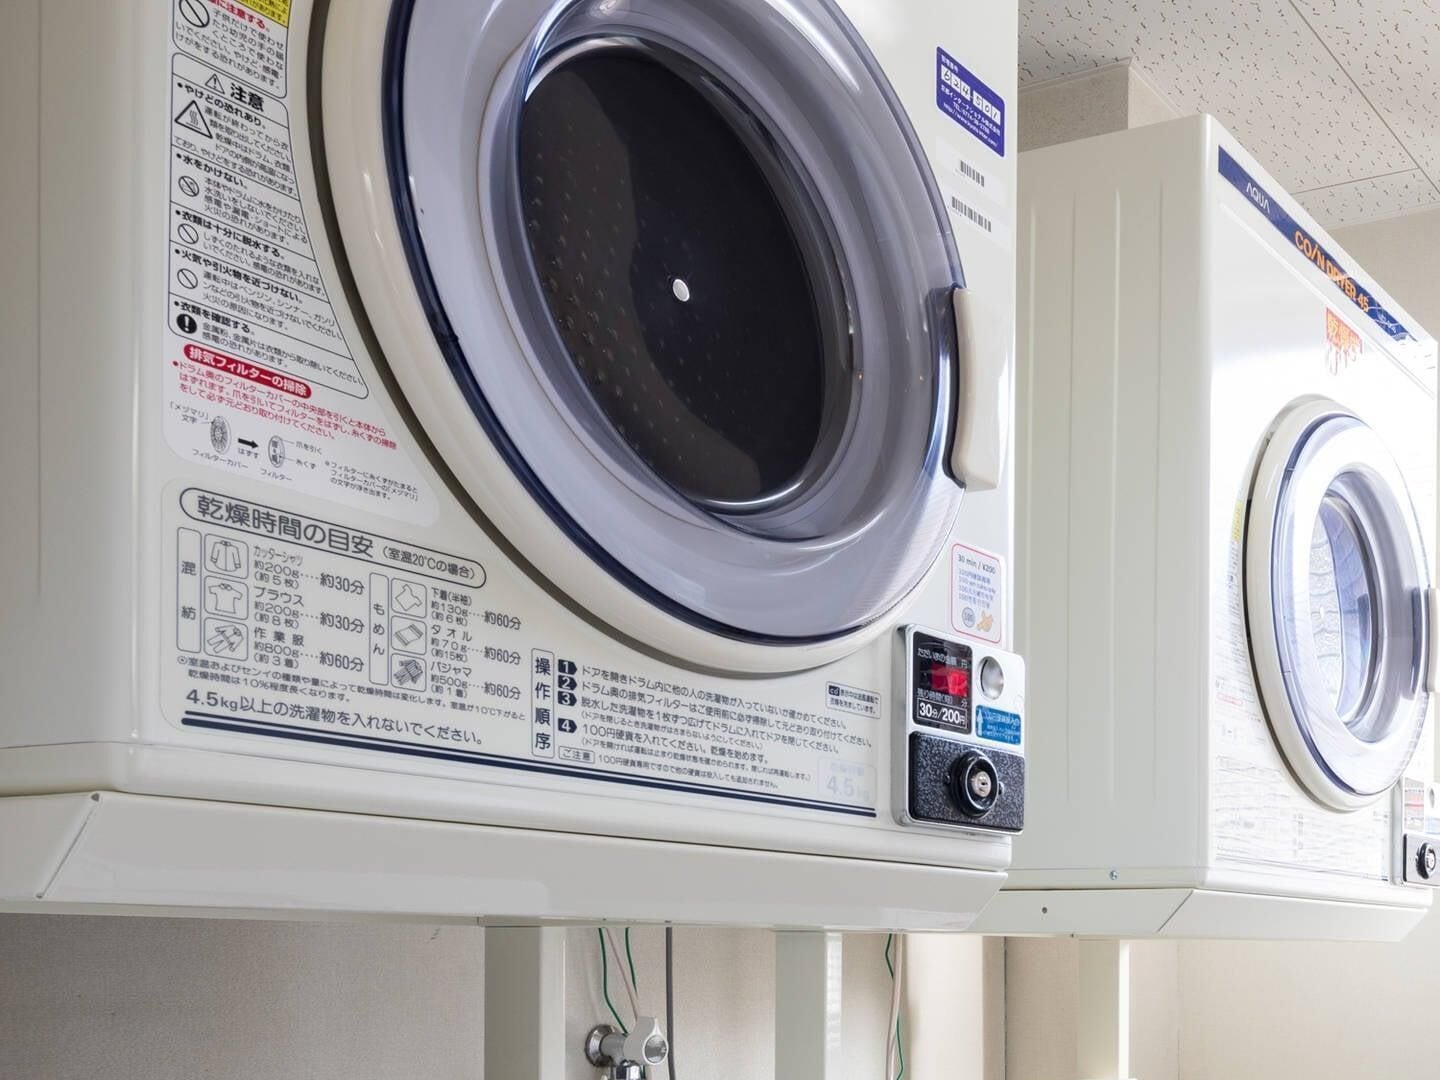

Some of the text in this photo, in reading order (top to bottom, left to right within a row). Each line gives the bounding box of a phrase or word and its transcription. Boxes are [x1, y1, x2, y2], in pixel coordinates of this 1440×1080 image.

[230, 81, 263, 113] 注意
[1246, 181, 1270, 213] AQUA
[1295, 230, 1324, 270] COIN
[188, 345, 306, 397] 排気フィルターの掃除
[196, 492, 374, 559] 乾燥時間の目安
[253, 585, 304, 608] ブラウス
[430, 660, 472, 678] パジャマ
[561, 676, 569, 689] 2
[534, 656, 551, 751] 操作順序
[561, 692, 569, 705] 3
[185, 685, 483, 748] 4.5kg以上の洗濯物を入れないでください。
[560, 719, 570, 732] 4
[561, 748, 590, 761] ご注意
